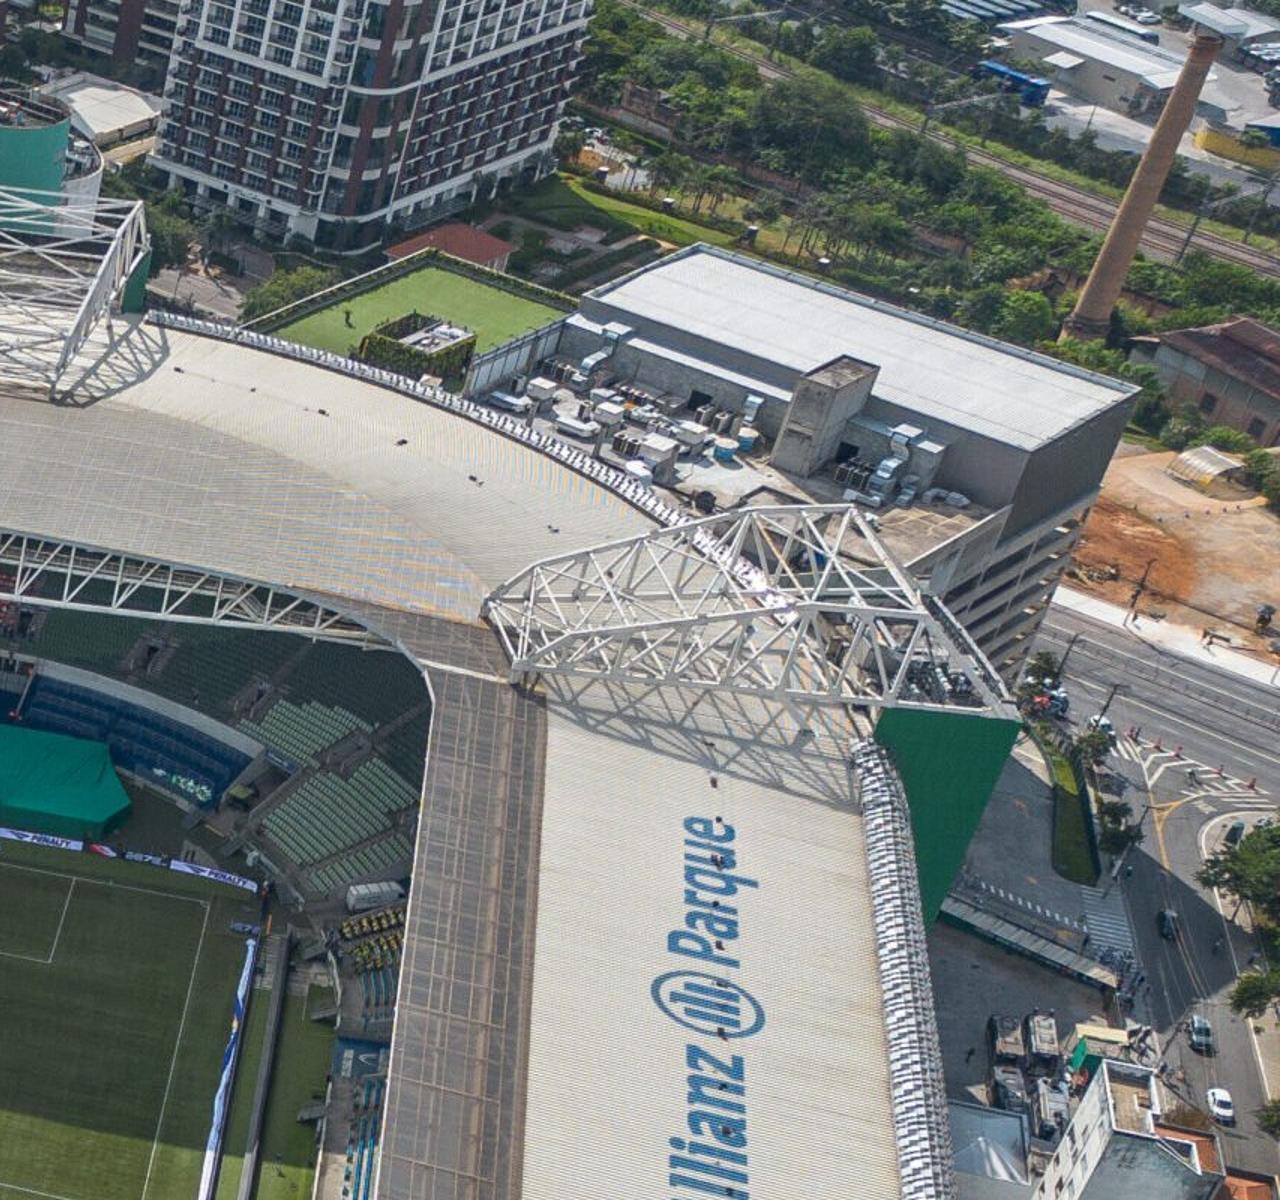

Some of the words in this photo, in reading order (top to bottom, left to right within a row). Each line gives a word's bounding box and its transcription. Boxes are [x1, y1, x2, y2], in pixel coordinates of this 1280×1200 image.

[31, 834, 72, 848] PENALTY
[208, 870, 248, 887] PENALTY
[667, 815, 760, 970] Parque
